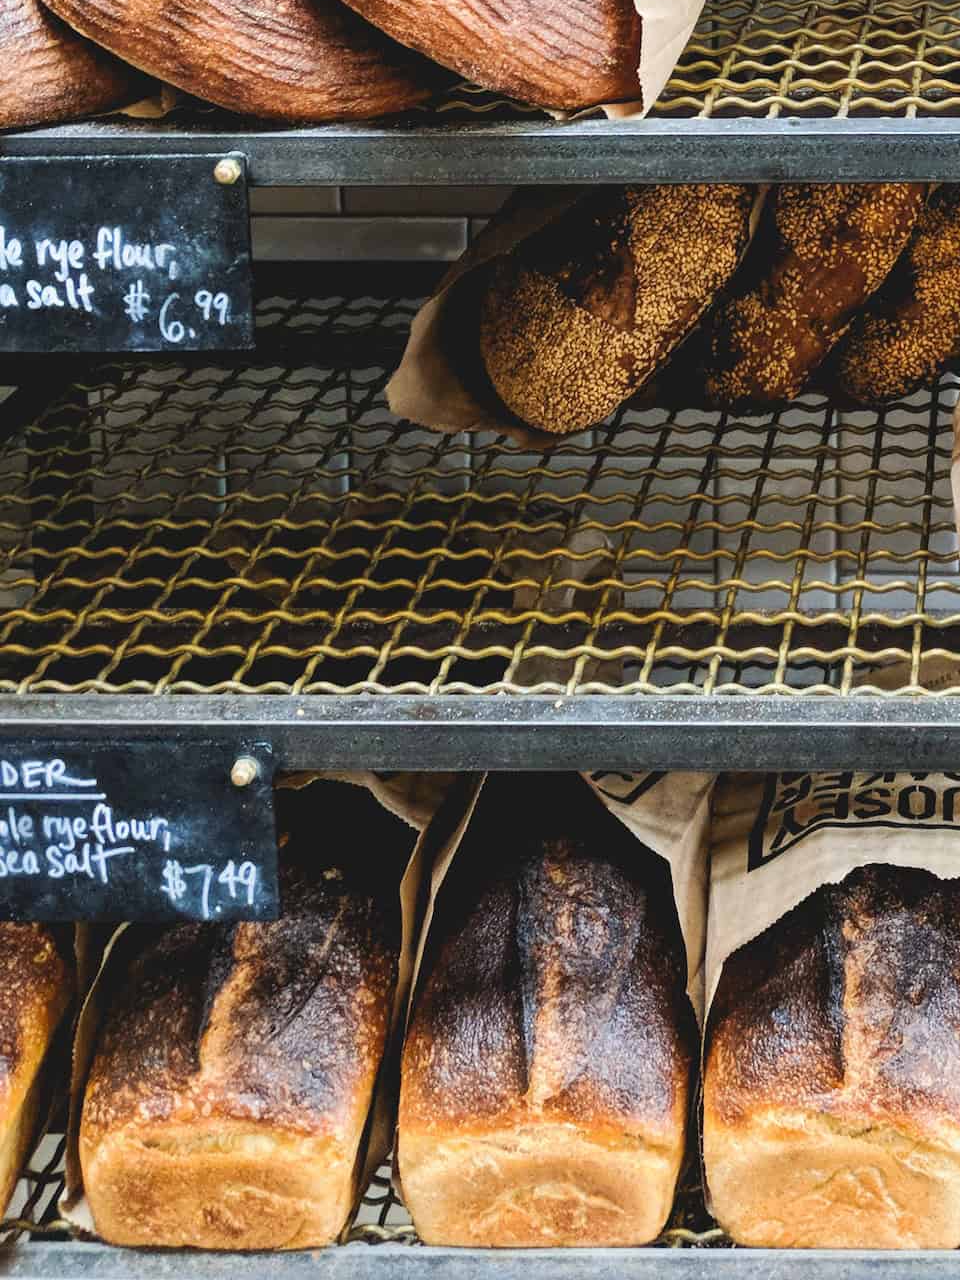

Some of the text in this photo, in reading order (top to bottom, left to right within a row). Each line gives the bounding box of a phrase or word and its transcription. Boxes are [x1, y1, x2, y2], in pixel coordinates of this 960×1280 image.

[35, 238, 85, 282] rye
[92, 225, 177, 280] flour,
[26, 272, 95, 313] salt
[123, 279, 230, 343] $6.99
[43, 815, 89, 850] rye
[90, 802, 171, 852] flour,
